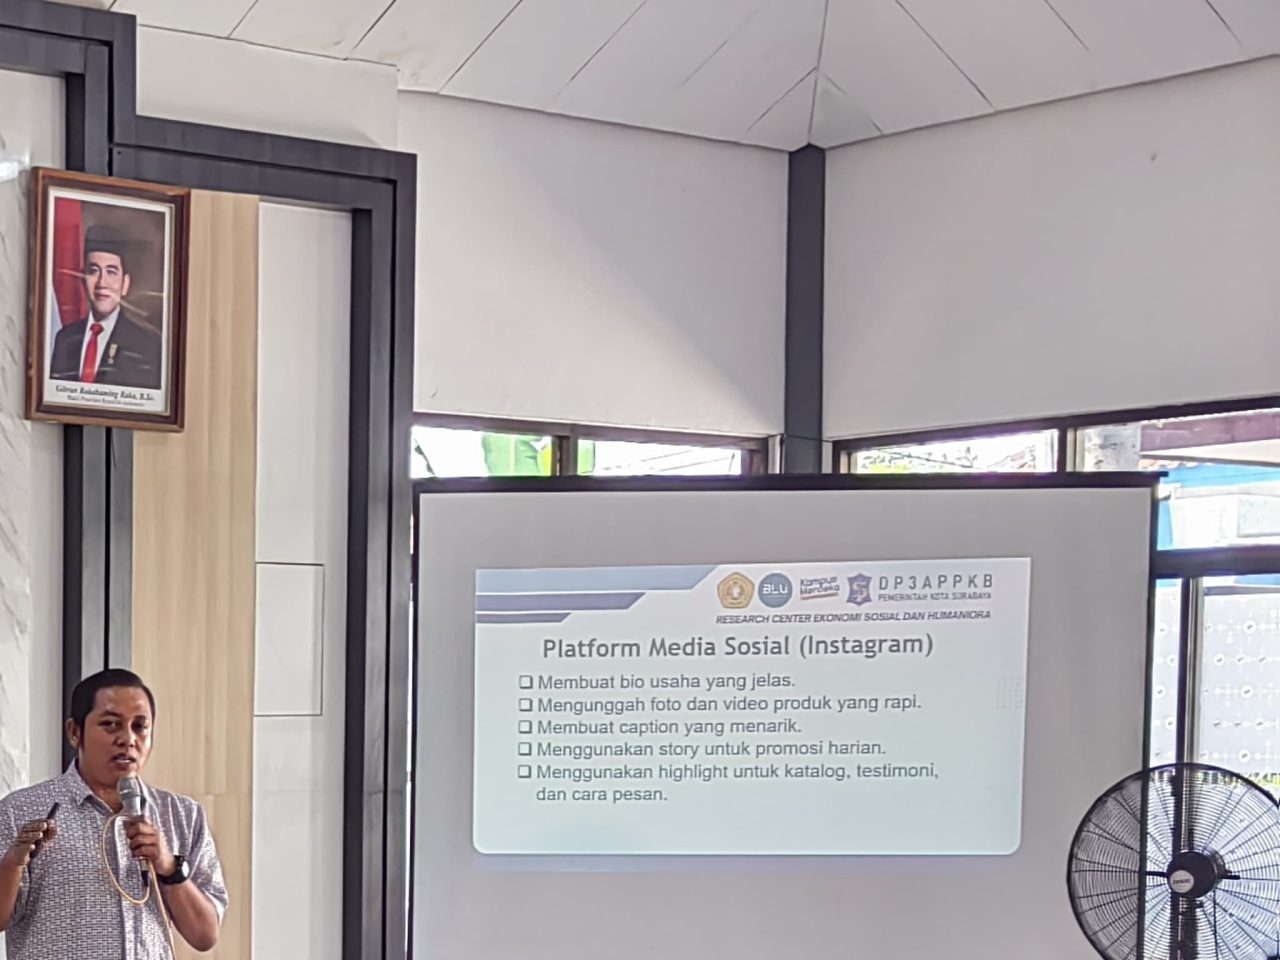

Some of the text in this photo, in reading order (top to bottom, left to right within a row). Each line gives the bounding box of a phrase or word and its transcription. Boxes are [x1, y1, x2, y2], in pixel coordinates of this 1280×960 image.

[762, 584, 787, 594] BLU
[879, 592, 927, 601] PEMERINTAH
[716, 611, 991, 623] RESEARCH CENTER EKONOMI SOSIAL DAN HUMANIORA
[543, 633, 933, 659] Platform Media Sosial (Instagram)
[538, 672, 796, 692] Membuat bio usaha yang jelas.
[538, 695, 922, 715] Mengunggah foto dan video produk yang rapi.
[537, 719, 802, 737] Membuat caption yang menarik.
[537, 740, 886, 759] Menggunakan story untuk promosi harian.
[537, 762, 939, 783] Menggunakan highlight untuk katalog, testimoni,
[537, 786, 668, 805] dan cara pesan.
